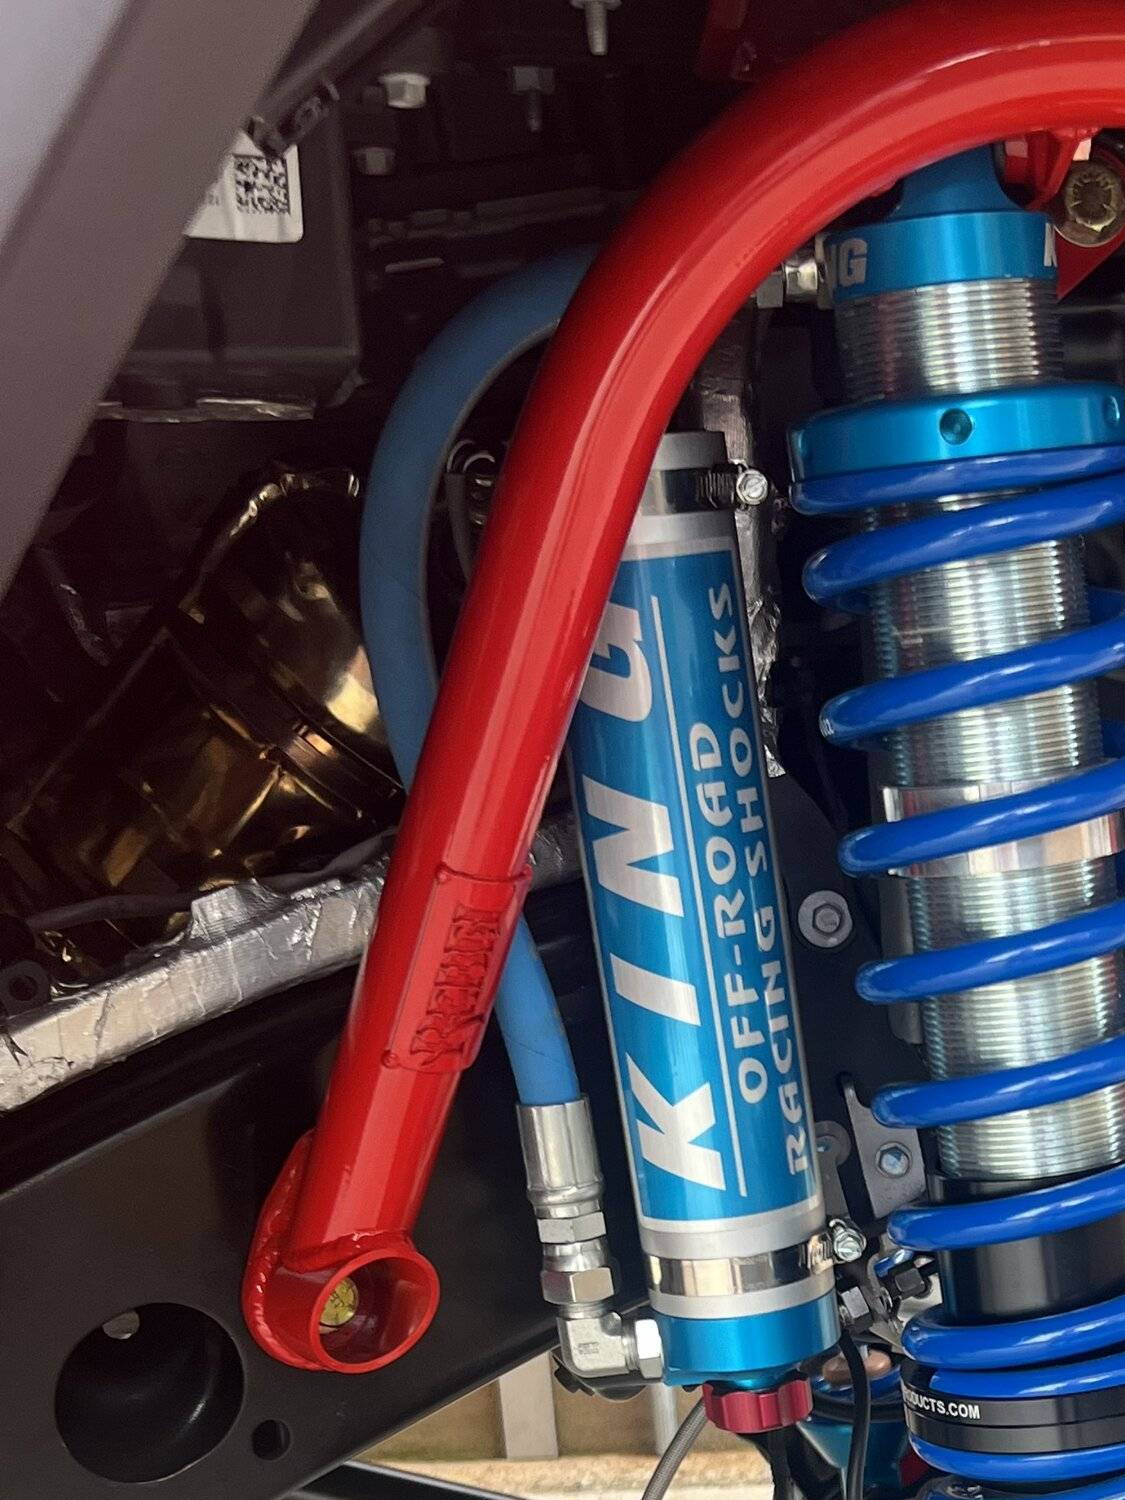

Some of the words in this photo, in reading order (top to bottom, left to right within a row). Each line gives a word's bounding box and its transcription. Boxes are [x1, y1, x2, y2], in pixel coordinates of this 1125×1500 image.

[578, 602, 726, 1191] KING
[708, 582, 768, 878] SHOCKS
[689, 722, 769, 1104] OFF-ROAD
[758, 905, 810, 1176] RACING
